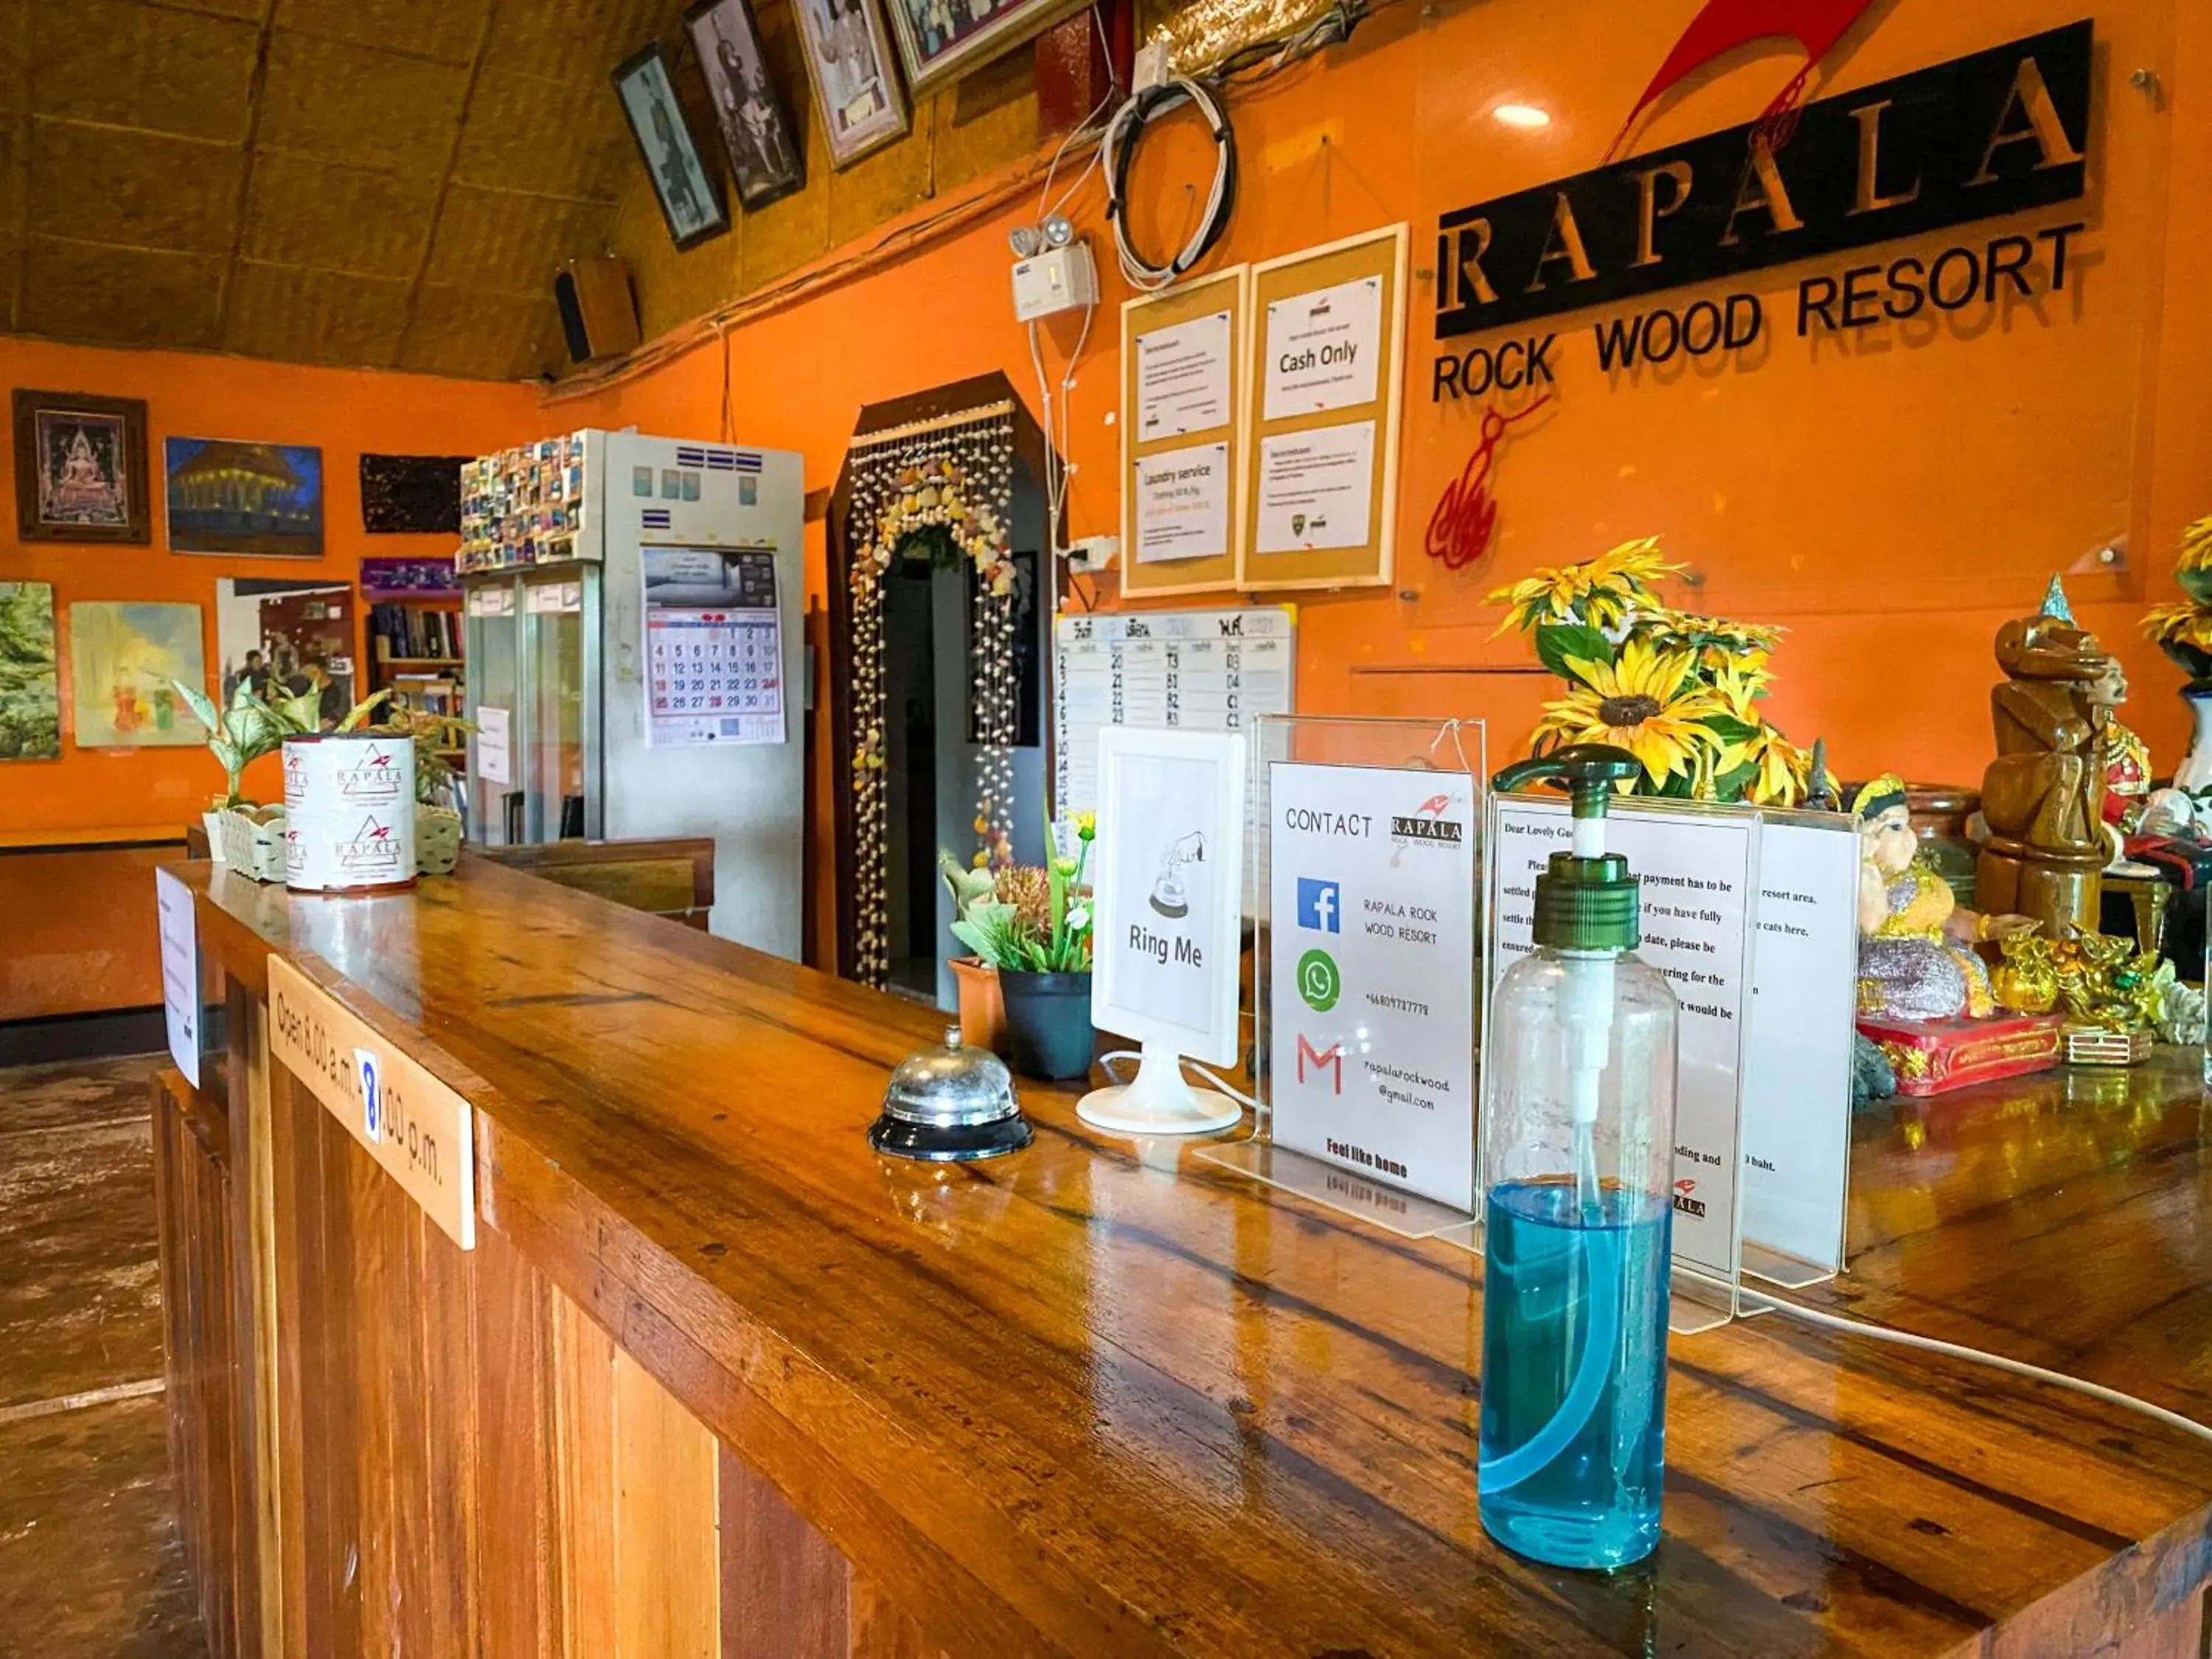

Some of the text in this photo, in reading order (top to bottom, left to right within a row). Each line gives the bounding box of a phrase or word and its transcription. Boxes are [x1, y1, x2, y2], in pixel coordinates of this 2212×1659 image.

[1438, 56, 2085, 312] RAPALA
[1433, 223, 2085, 402] ROCK WOOD RESORT
[1279, 340, 1357, 373] Cash Only
[1178, 464, 1211, 480] service
[747, 627, 754, 639] 2
[655, 645, 663, 655] 4
[675, 645, 682, 656] 5
[693, 645, 700, 656] 6
[712, 645, 718, 656] 7
[730, 645, 736, 656] 8
[747, 644, 754, 656] 9
[674, 663, 685, 674] 12
[693, 663, 703, 674] 13
[711, 662, 721, 673] 14
[728, 662, 739, 673] 15
[746, 661, 756, 672] 16
[674, 679, 685, 690] 19
[692, 679, 704, 690] 20
[710, 679, 721, 690] 21
[727, 679, 740, 690] 22
[744, 678, 757, 689] 23
[761, 678, 776, 689] 24
[673, 698, 686, 708] 26
[691, 697, 703, 708] 27
[709, 696, 722, 707] 28
[727, 696, 740, 707] 29
[745, 696, 757, 707] 30
[1286, 807, 1461, 841] CONTACT RAPALA
[1504, 823, 1525, 834] Dear
[1527, 825, 1555, 838] Lovely
[1644, 873, 1686, 888] payment
[1688, 877, 1705, 889] has
[1707, 880, 1717, 891] to
[1719, 882, 1733, 892] be
[1503, 887, 1530, 897] settled
[1762, 889, 1790, 901] resort
[1364, 899, 1437, 922] RAPALA ROCK
[1503, 914, 1524, 925] settle
[1644, 902, 1652, 914] if
[1653, 905, 1671, 917] you
[1673, 907, 1698, 919] have
[1700, 910, 1722, 925] fully
[1365, 922, 1437, 944] WOOD RESORT
[1763, 922, 1782, 933] cats
[1129, 924, 1203, 968] Ring Me
[1502, 942, 1534, 953] ensured
[1644, 933, 1668, 947] date,
[1670, 937, 1701, 951] please
[1703, 942, 1717, 953] be
[1691, 969, 1706, 983] for
[1708, 972, 1725, 987] the
[1688, 1003, 1718, 1017] would
[1720, 1007, 1733, 1020] be
[1364, 1061, 1450, 1092] rapalarockwood
[276, 991, 303, 1051] Open
[305, 1015, 327, 1072] 8.00
[330, 1048, 355, 1100] a.m.
[409, 1120, 442, 1186] p.m.
[1379, 1084, 1435, 1110] @gmail.com
[1326, 1138, 1408, 1178] Feel like home
[1702, 1153, 1722, 1166] and
